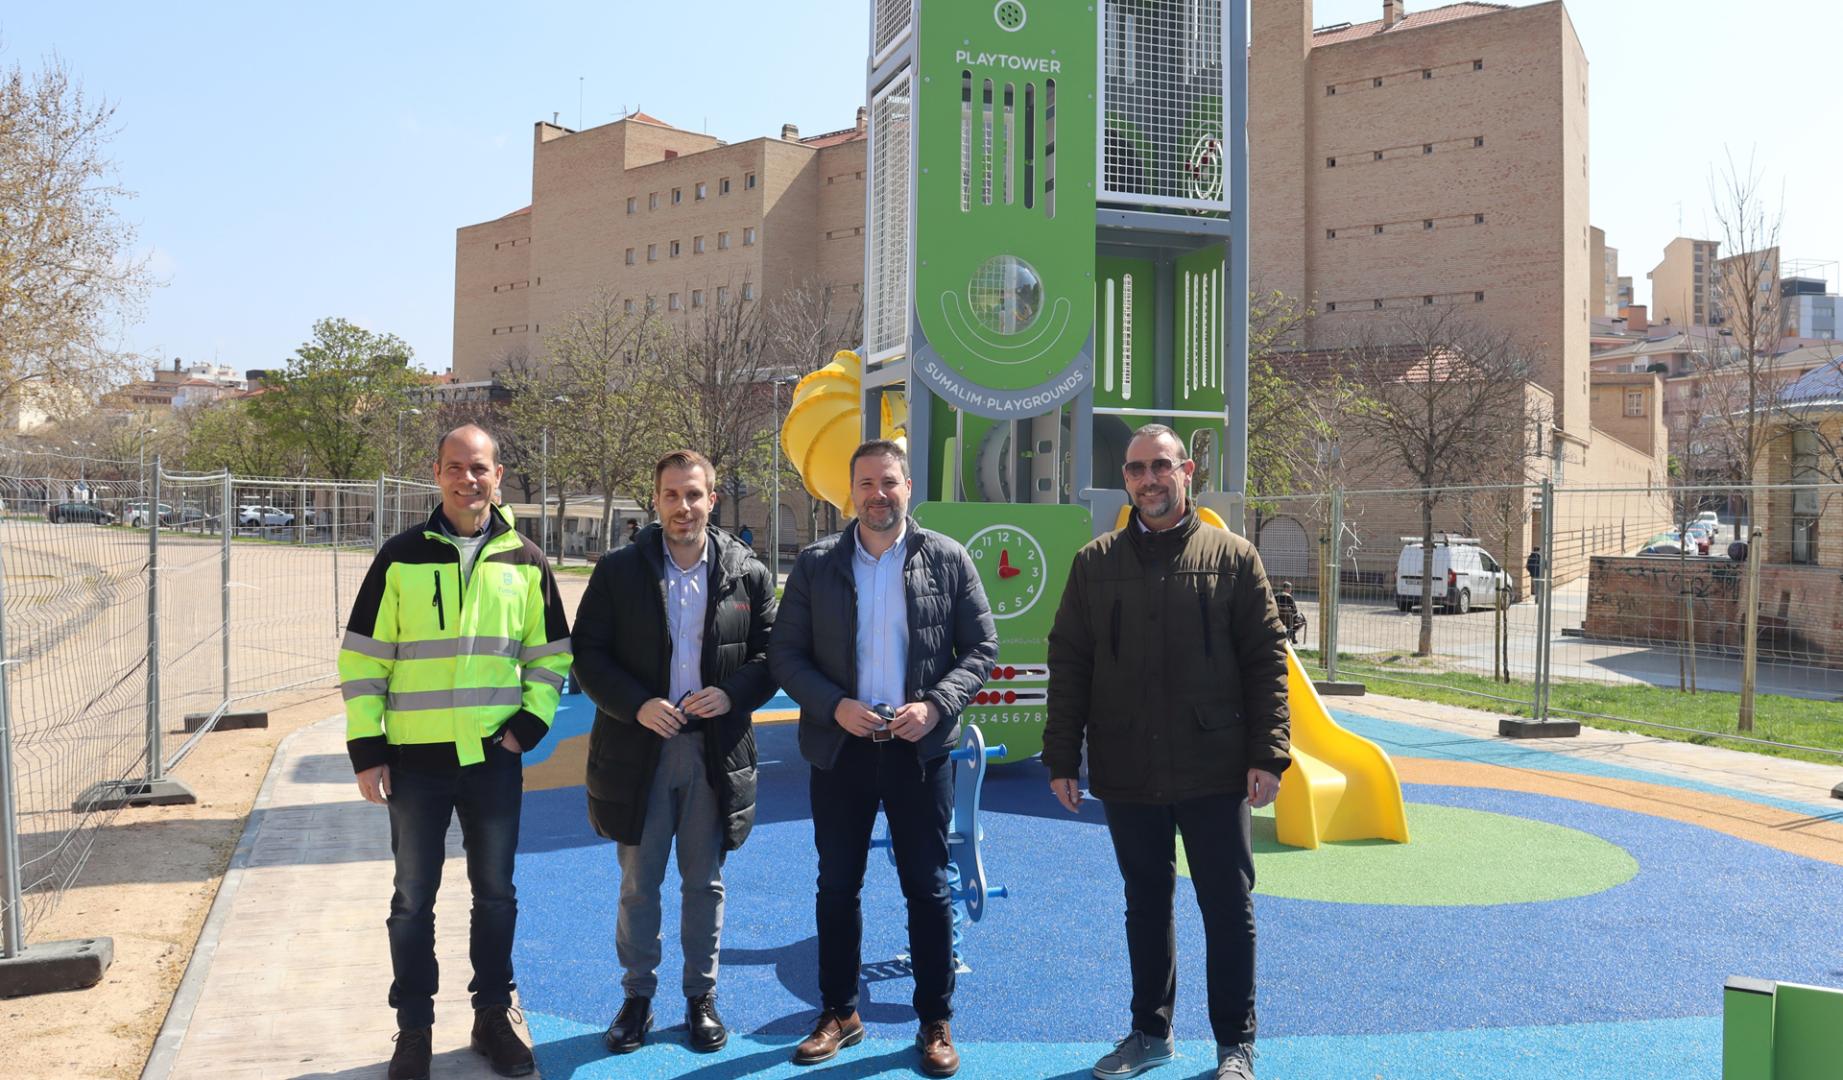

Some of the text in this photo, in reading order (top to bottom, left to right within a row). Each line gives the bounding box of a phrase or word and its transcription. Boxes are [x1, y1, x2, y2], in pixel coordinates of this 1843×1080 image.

[956, 50, 1061, 73] PLAYTOWER
[925, 361, 1084, 411] SUMALIM PLAYGROUNDS
[982, 536, 992, 547] 11
[997, 532, 1009, 543] 12
[970, 549, 984, 560] 10
[1027, 550, 1036, 561] 2
[1031, 567, 1040, 578] 3
[1026, 584, 1035, 595] 4
[998, 602, 1006, 613] 6
[1015, 597, 1023, 608] 5
[969, 714, 977, 724] 2
[979, 713, 987, 724] 3
[990, 713, 999, 723] 4
[1001, 713, 1009, 723] 5
[1012, 712, 1020, 723] 6
[1023, 712, 1031, 723] 7
[1034, 712, 1042, 722] 8
